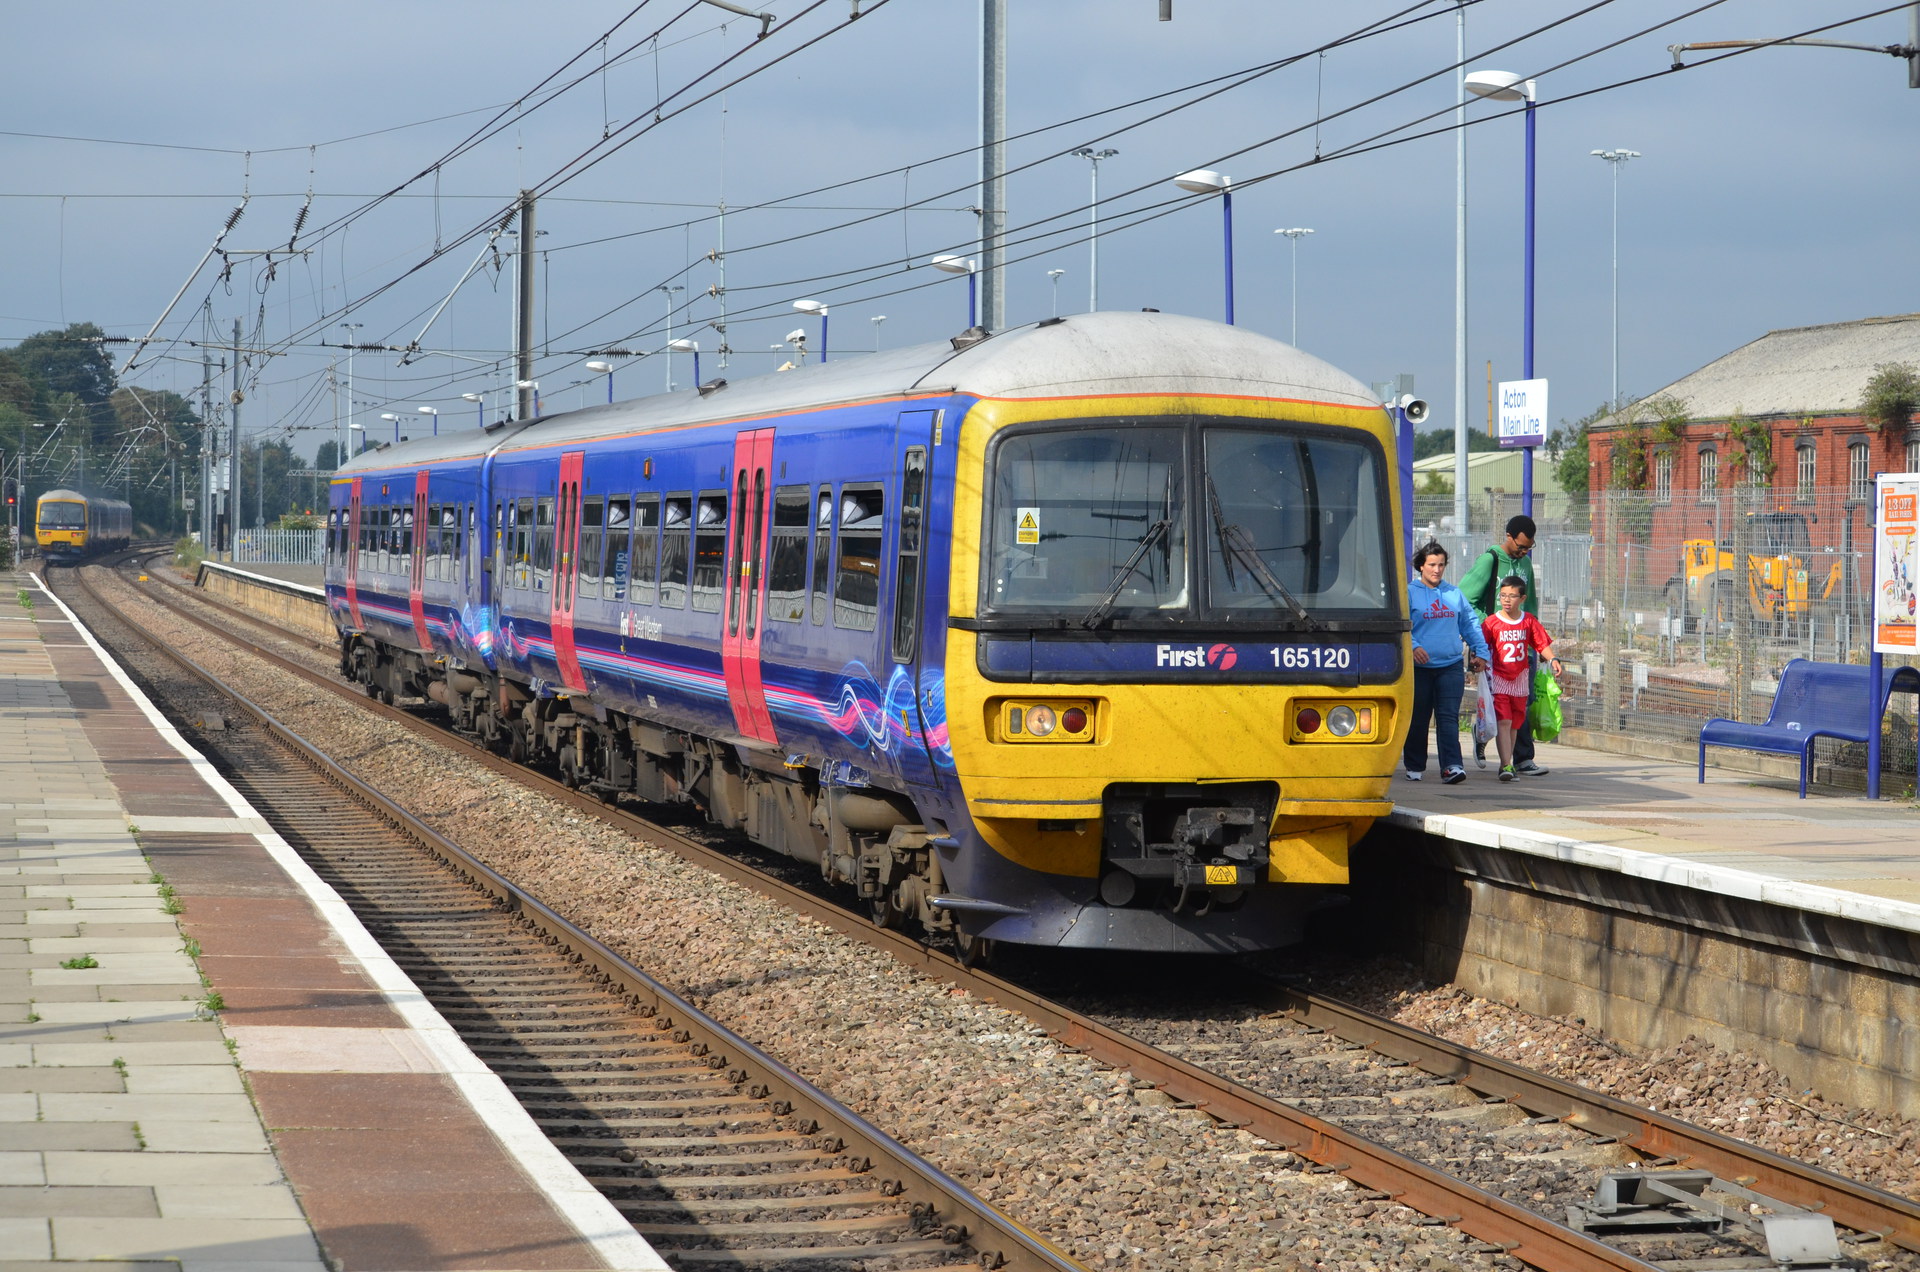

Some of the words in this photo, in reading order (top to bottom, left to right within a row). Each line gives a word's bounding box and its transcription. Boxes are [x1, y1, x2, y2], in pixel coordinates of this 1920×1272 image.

[1503, 388, 1526, 408] Acton
[1503, 415, 1521, 436] Main
[1523, 414, 1540, 434] Line
[1156, 644, 1206, 668] First
[1270, 647, 1350, 669] 165120
[1502, 642, 1526, 662] 23
